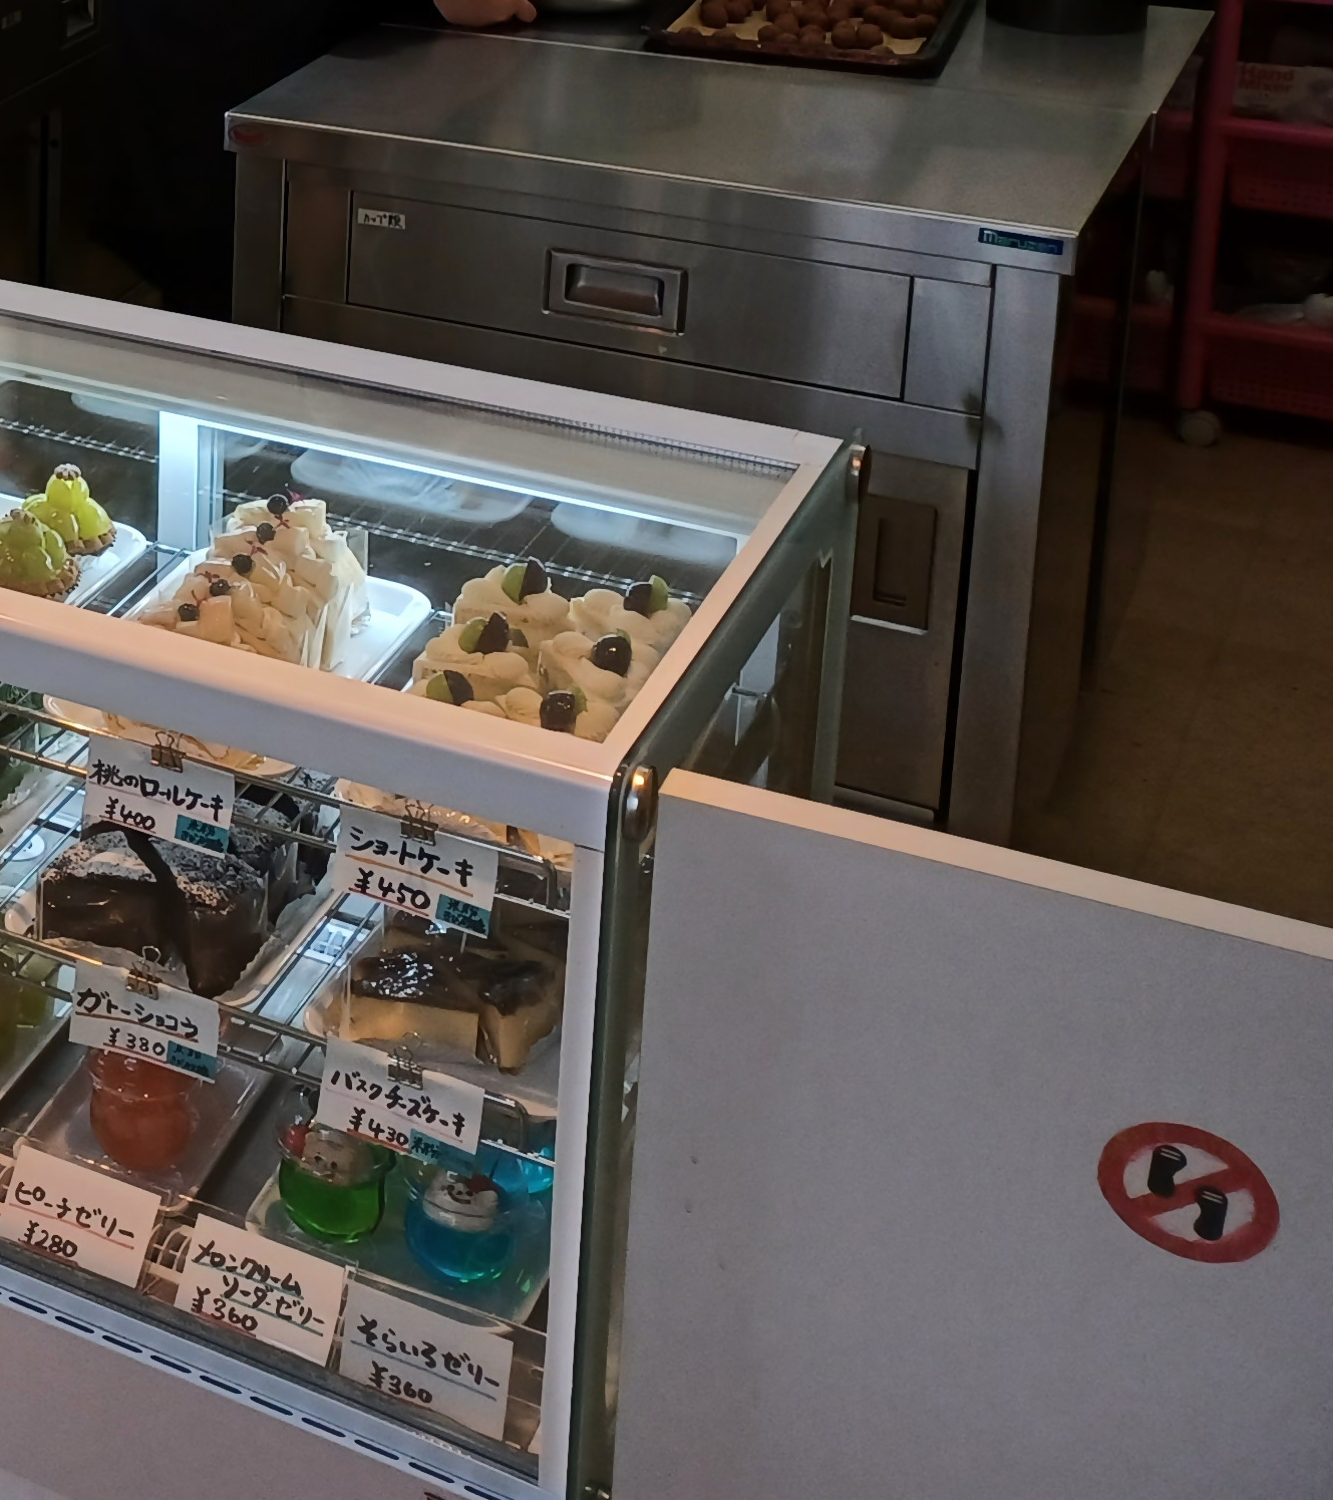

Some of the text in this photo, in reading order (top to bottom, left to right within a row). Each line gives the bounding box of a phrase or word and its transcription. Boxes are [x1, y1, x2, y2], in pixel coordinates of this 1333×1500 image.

[88, 758, 225, 823] 桃のロールケーキ
[103, 795, 156, 831] ¥400
[349, 825, 475, 888] ショートケーキ
[353, 867, 432, 910] ¥450
[76, 986, 200, 1040] ガトーショコラ
[108, 1026, 166, 1057] ¥380
[330, 1069, 467, 1138] バスクチーズケーキ
[348, 1106, 410, 1146] ¥430
[14, 1180, 136, 1240] ピーチゼリー
[21, 1219, 79, 1260] ¥280
[192, 1239, 303, 1296] メロンクリーム
[191, 1285, 260, 1334] ¥360
[356, 1313, 501, 1390] そらいろゼリー
[367, 1360, 434, 1405] ¥360
